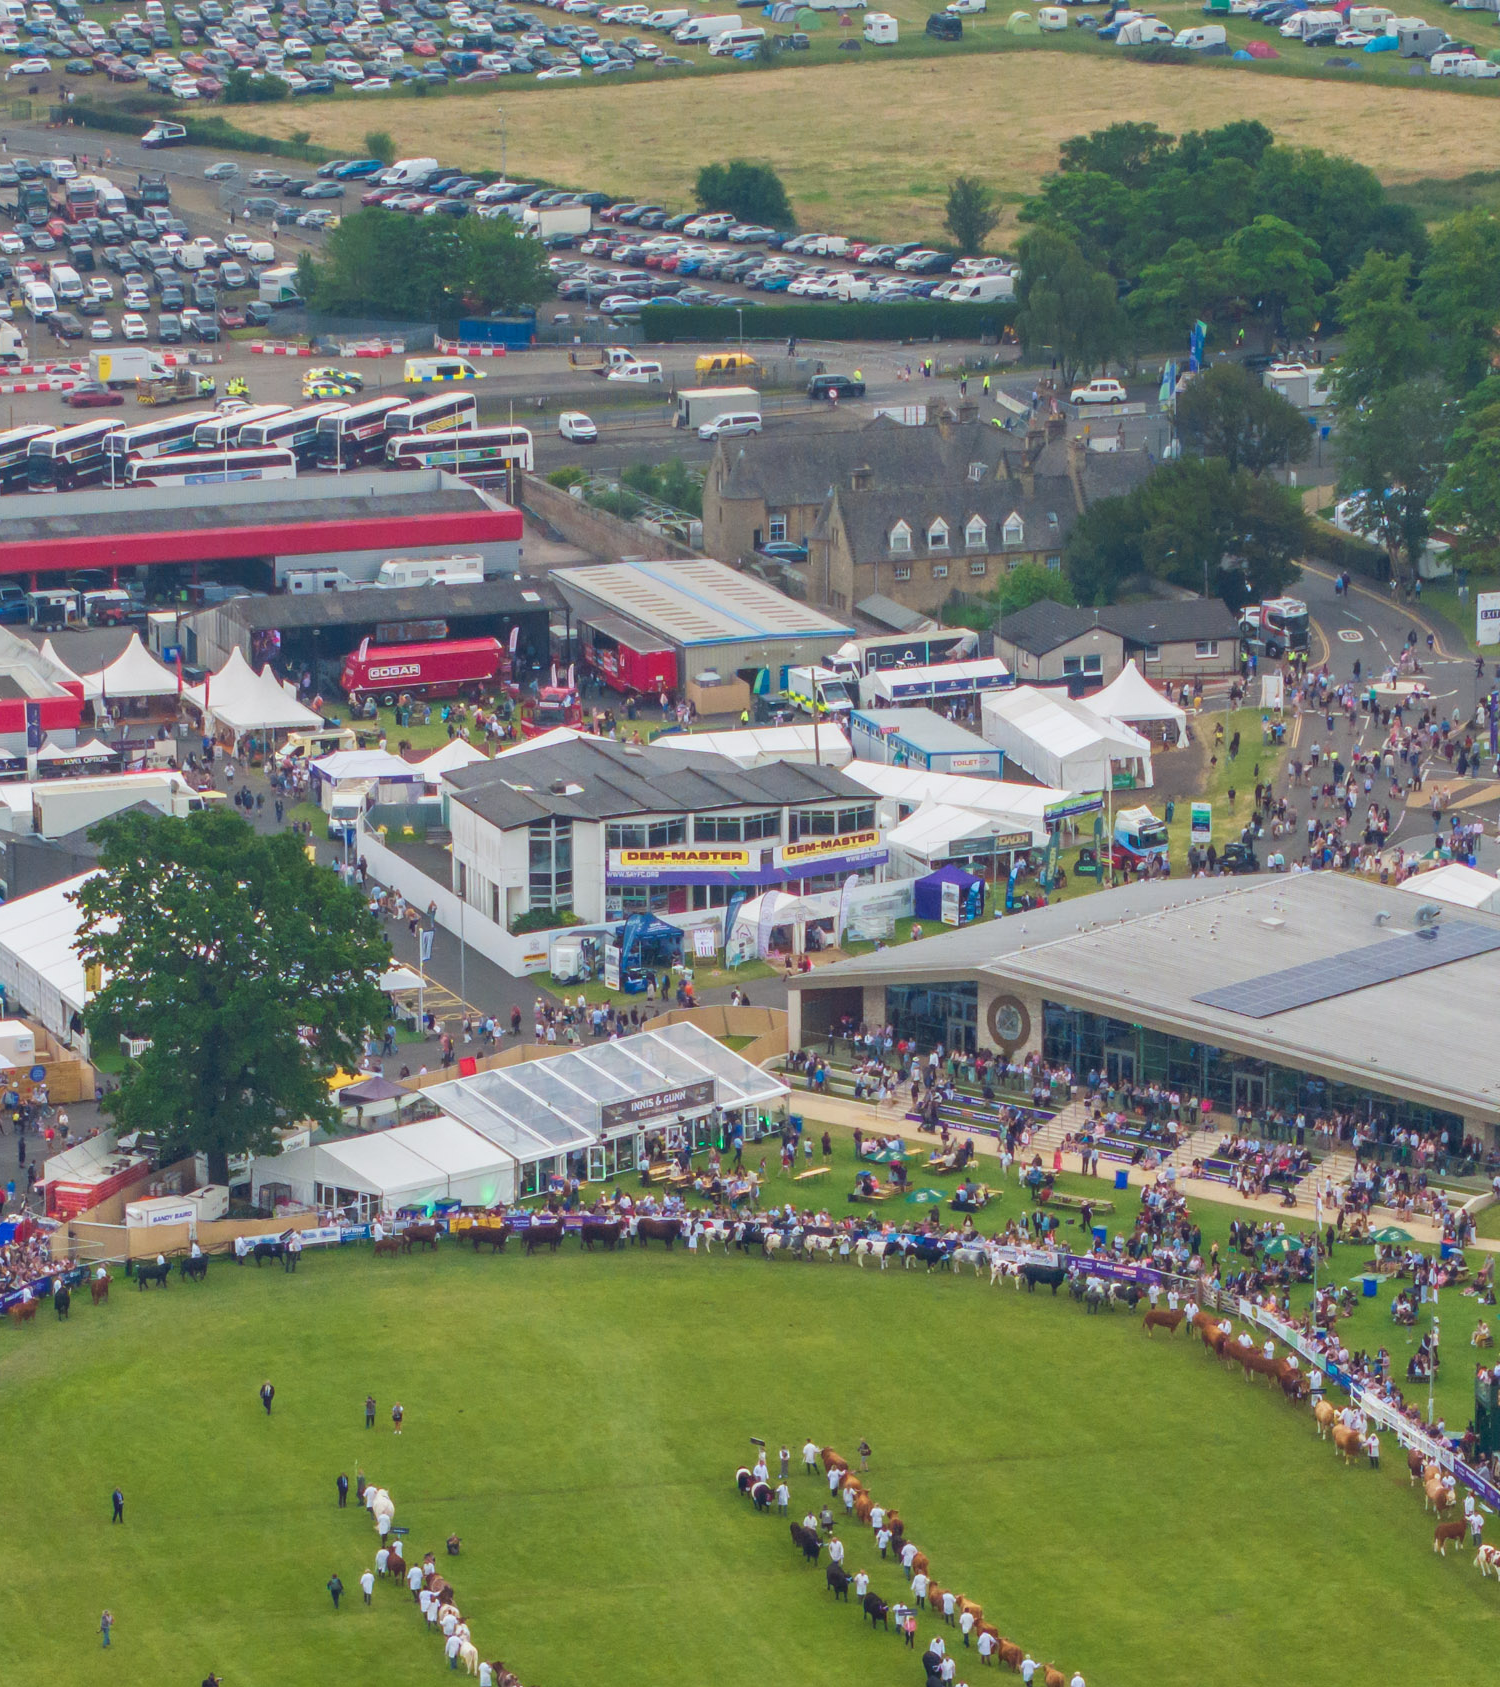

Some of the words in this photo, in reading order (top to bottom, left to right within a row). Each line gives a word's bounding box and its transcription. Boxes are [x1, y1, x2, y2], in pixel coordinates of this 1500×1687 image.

[1481, 610, 1500, 619] EXIT
[370, 665, 419, 678] GOGAR
[952, 758, 978, 767] TOILET
[787, 833, 875, 855] DEM-MASTER
[627, 851, 742, 861] DEM-MASTER
[631, 1098, 655, 1112] INNIS
[655, 1097, 662, 1106] &
[663, 1091, 686, 1104] GUNN
[153, 1215, 173, 1223] SANDY
[174, 1210, 193, 1219] BAIRD
